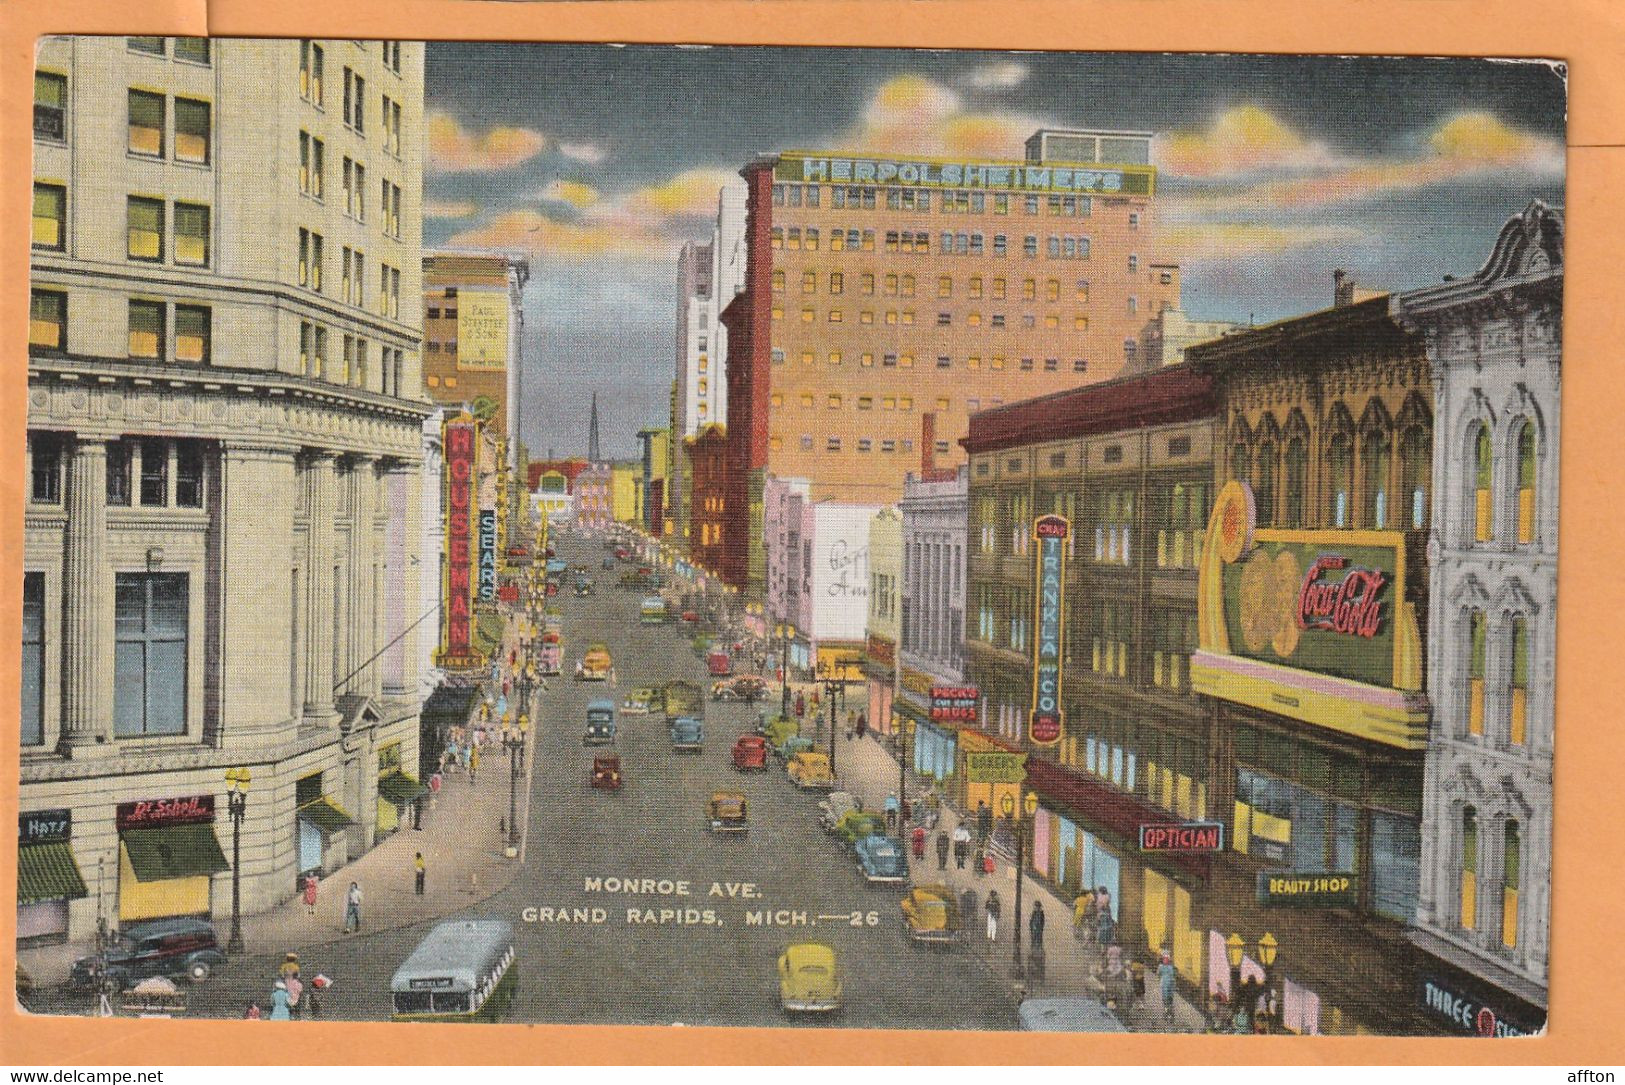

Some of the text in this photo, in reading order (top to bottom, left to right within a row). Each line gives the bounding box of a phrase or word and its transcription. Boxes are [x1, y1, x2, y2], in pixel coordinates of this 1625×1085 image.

[803, 157, 1121, 192] HERPOLSHEIMER'S
[449, 429, 471, 646] HOUSEMAN
[480, 515, 494, 600] SEARS
[1040, 537, 1059, 656] TRANKLA
[932, 707, 976, 720] DRUGS
[1144, 828, 1218, 849] OPTICIAN
[585, 878, 763, 898] MONROE AVE.
[1269, 878, 1349, 894] BEAUTY SHOP
[522, 908, 607, 923] GRAND
[627, 909, 724, 927] RAPIDS,
[1425, 982, 1473, 1028] THREE
